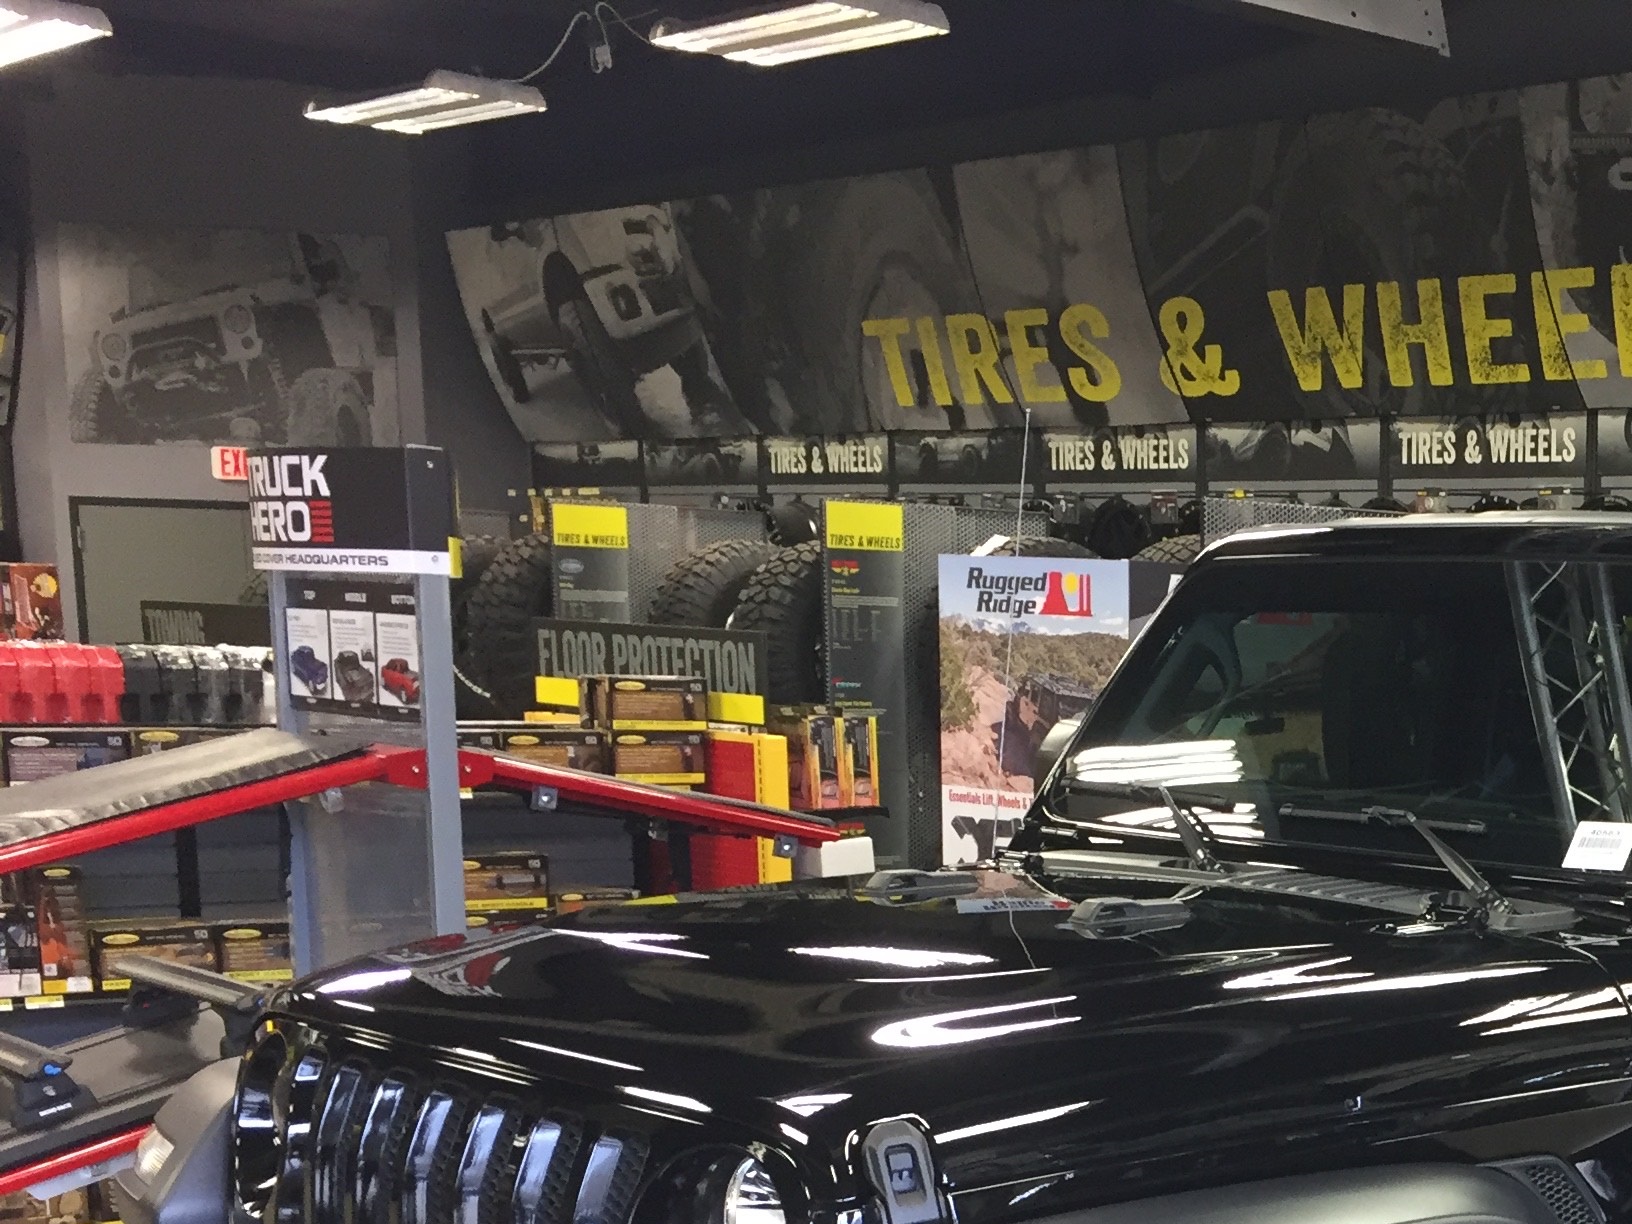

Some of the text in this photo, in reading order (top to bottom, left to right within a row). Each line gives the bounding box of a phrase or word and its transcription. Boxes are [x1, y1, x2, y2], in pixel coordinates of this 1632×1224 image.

[862, 303, 1122, 409] TIRES
[1160, 296, 1240, 398] &
[769, 444, 883, 474] TIRES & WHEELS
[1048, 438, 1189, 471] TIRES & WHEELS
[1398, 427, 1576, 465] TIRES & WHEELS
[220, 448, 248, 477] EXI
[248, 455, 331, 497] TRUCK
[251, 501, 312, 542] HERO
[557, 533, 625, 547] TIRES & WHEELS
[830, 534, 901, 549] TIRES & WHEELS
[285, 553, 389, 567] HEADQUARTERS
[967, 567, 1048, 595] Rugged
[977, 590, 1037, 618] Ridge
[537, 629, 756, 695] FLOOR PROTECTION
